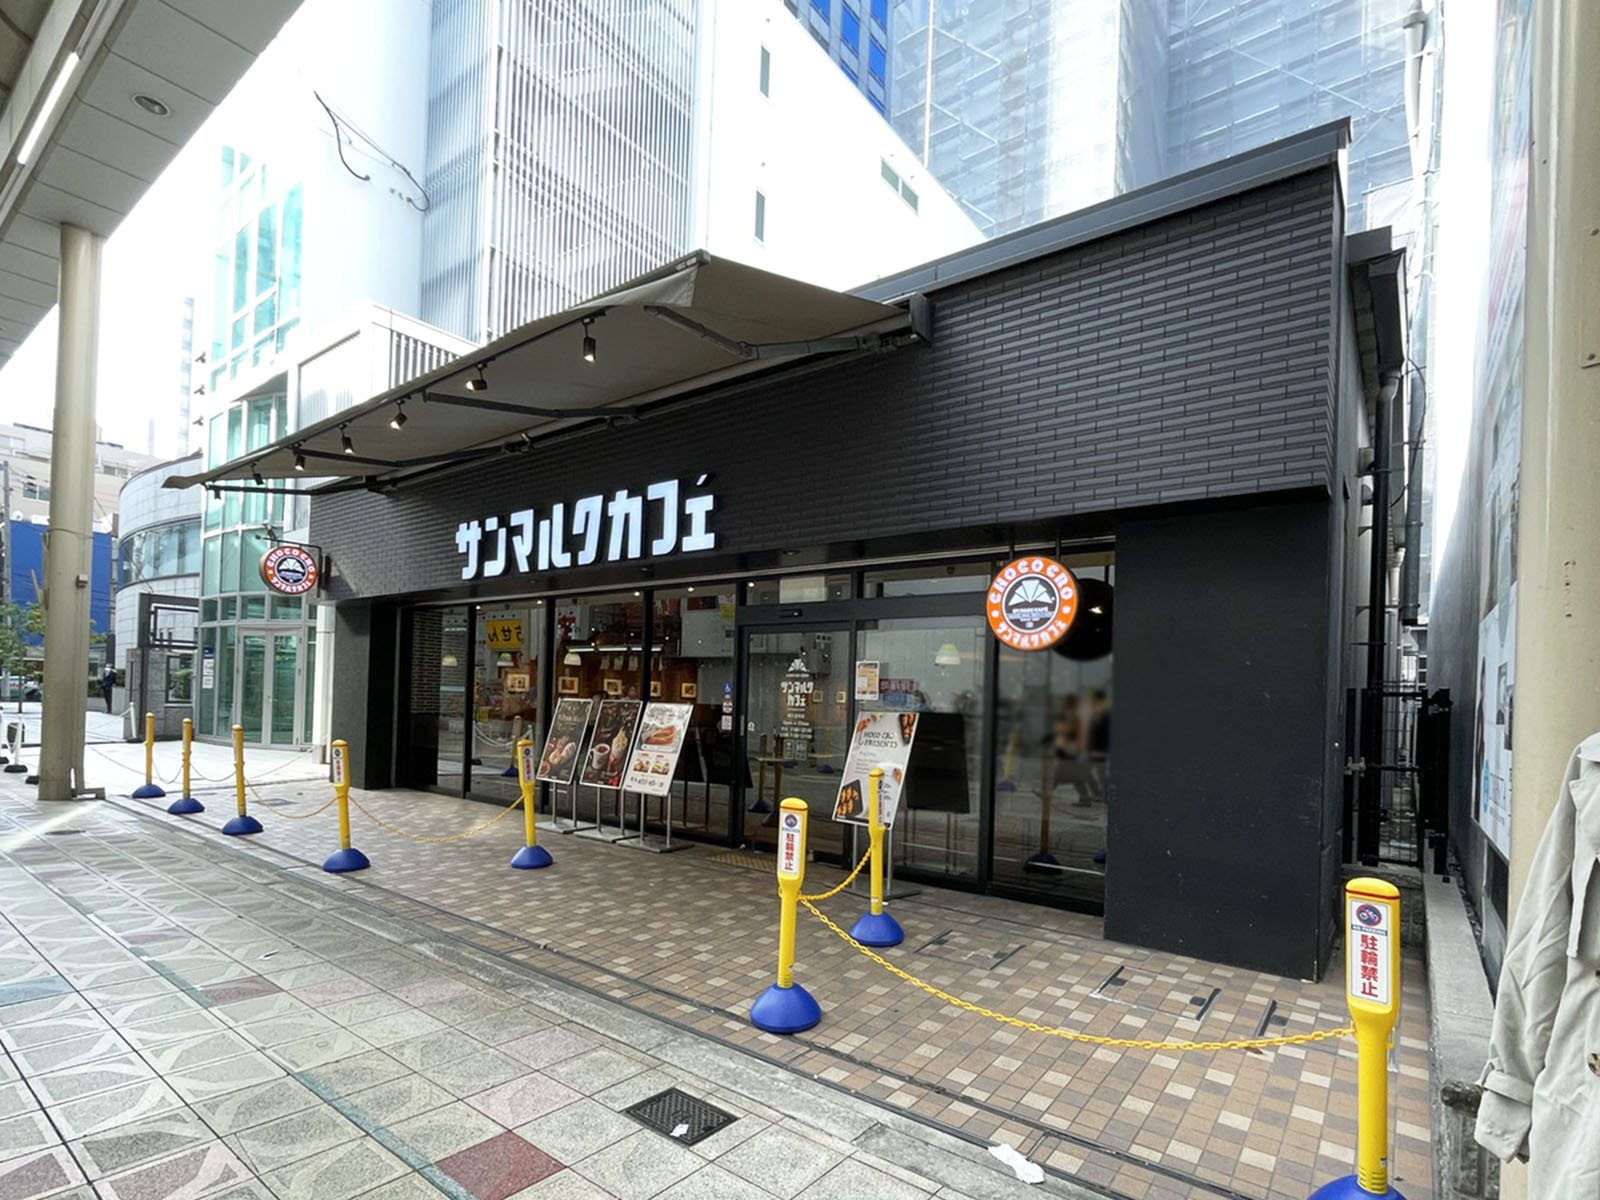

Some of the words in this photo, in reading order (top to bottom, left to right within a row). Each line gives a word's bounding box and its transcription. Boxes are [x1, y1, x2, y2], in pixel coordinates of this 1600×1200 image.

[455, 474, 715, 580] サンマルクカフェ
[1360, 934, 1379, 998] 駐輪禁止
